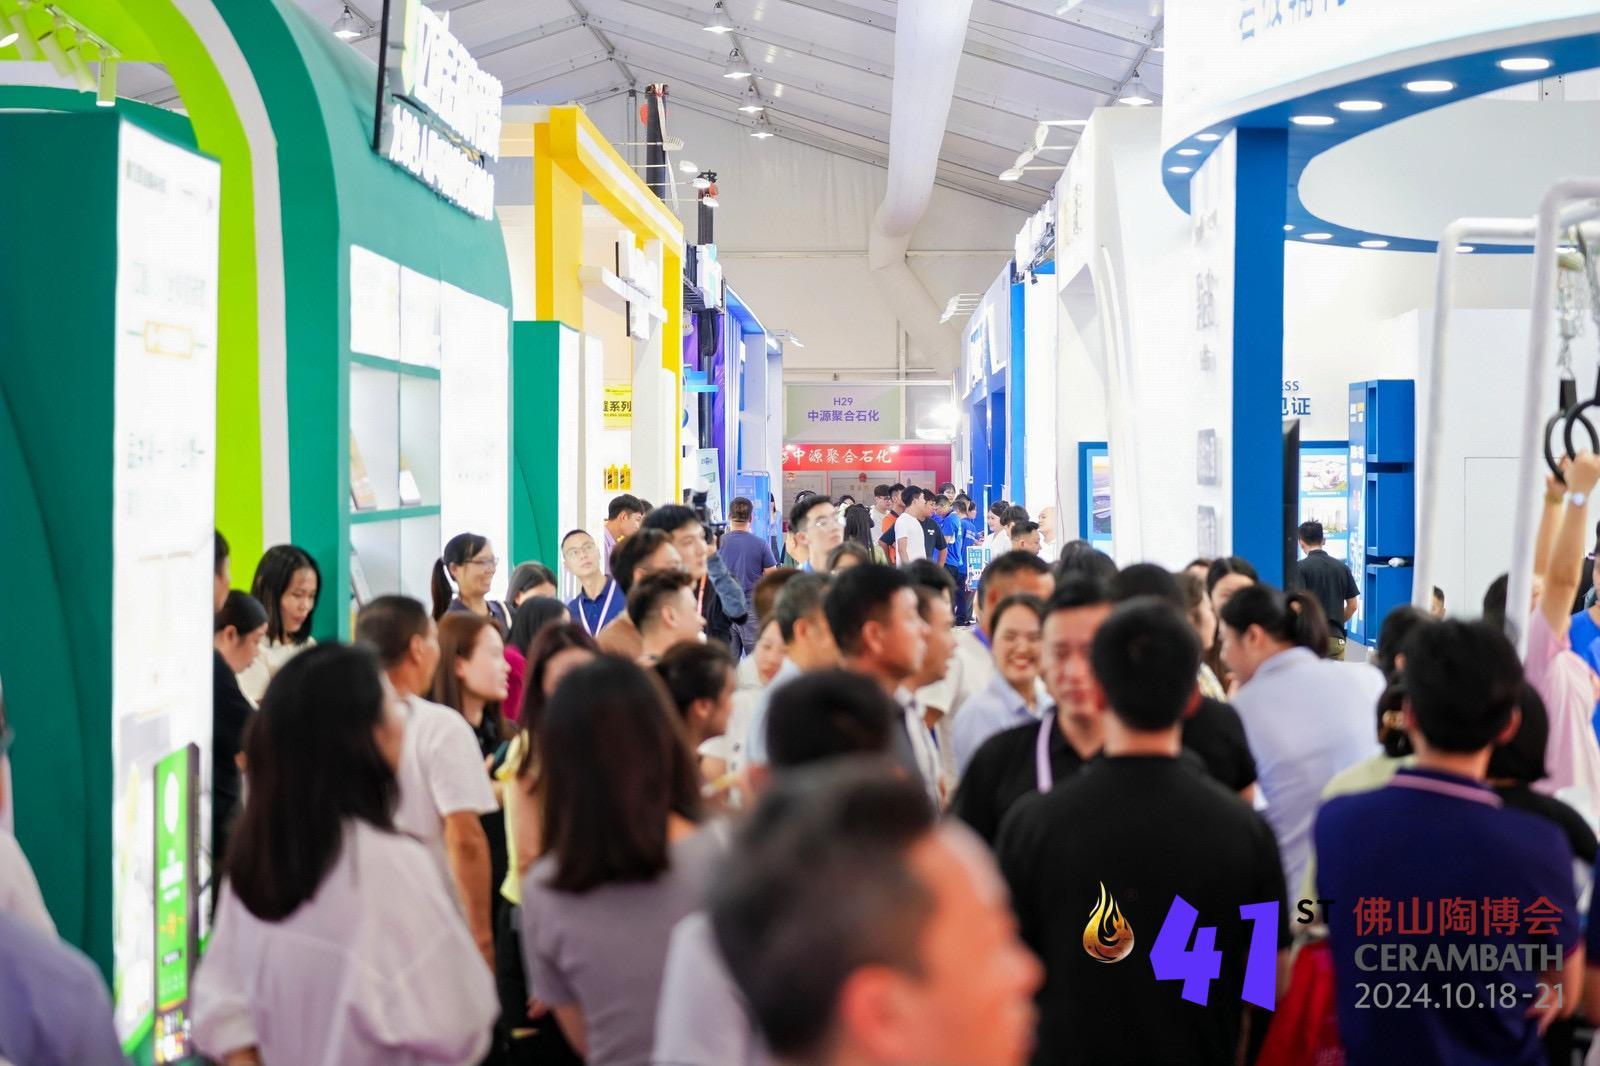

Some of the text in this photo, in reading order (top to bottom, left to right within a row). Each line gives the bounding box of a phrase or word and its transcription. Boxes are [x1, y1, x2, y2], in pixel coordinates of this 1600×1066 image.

[1282, 381, 1299, 391] SS
[833, 397, 854, 406] H29
[807, 409, 880, 422] 中源聚合石化
